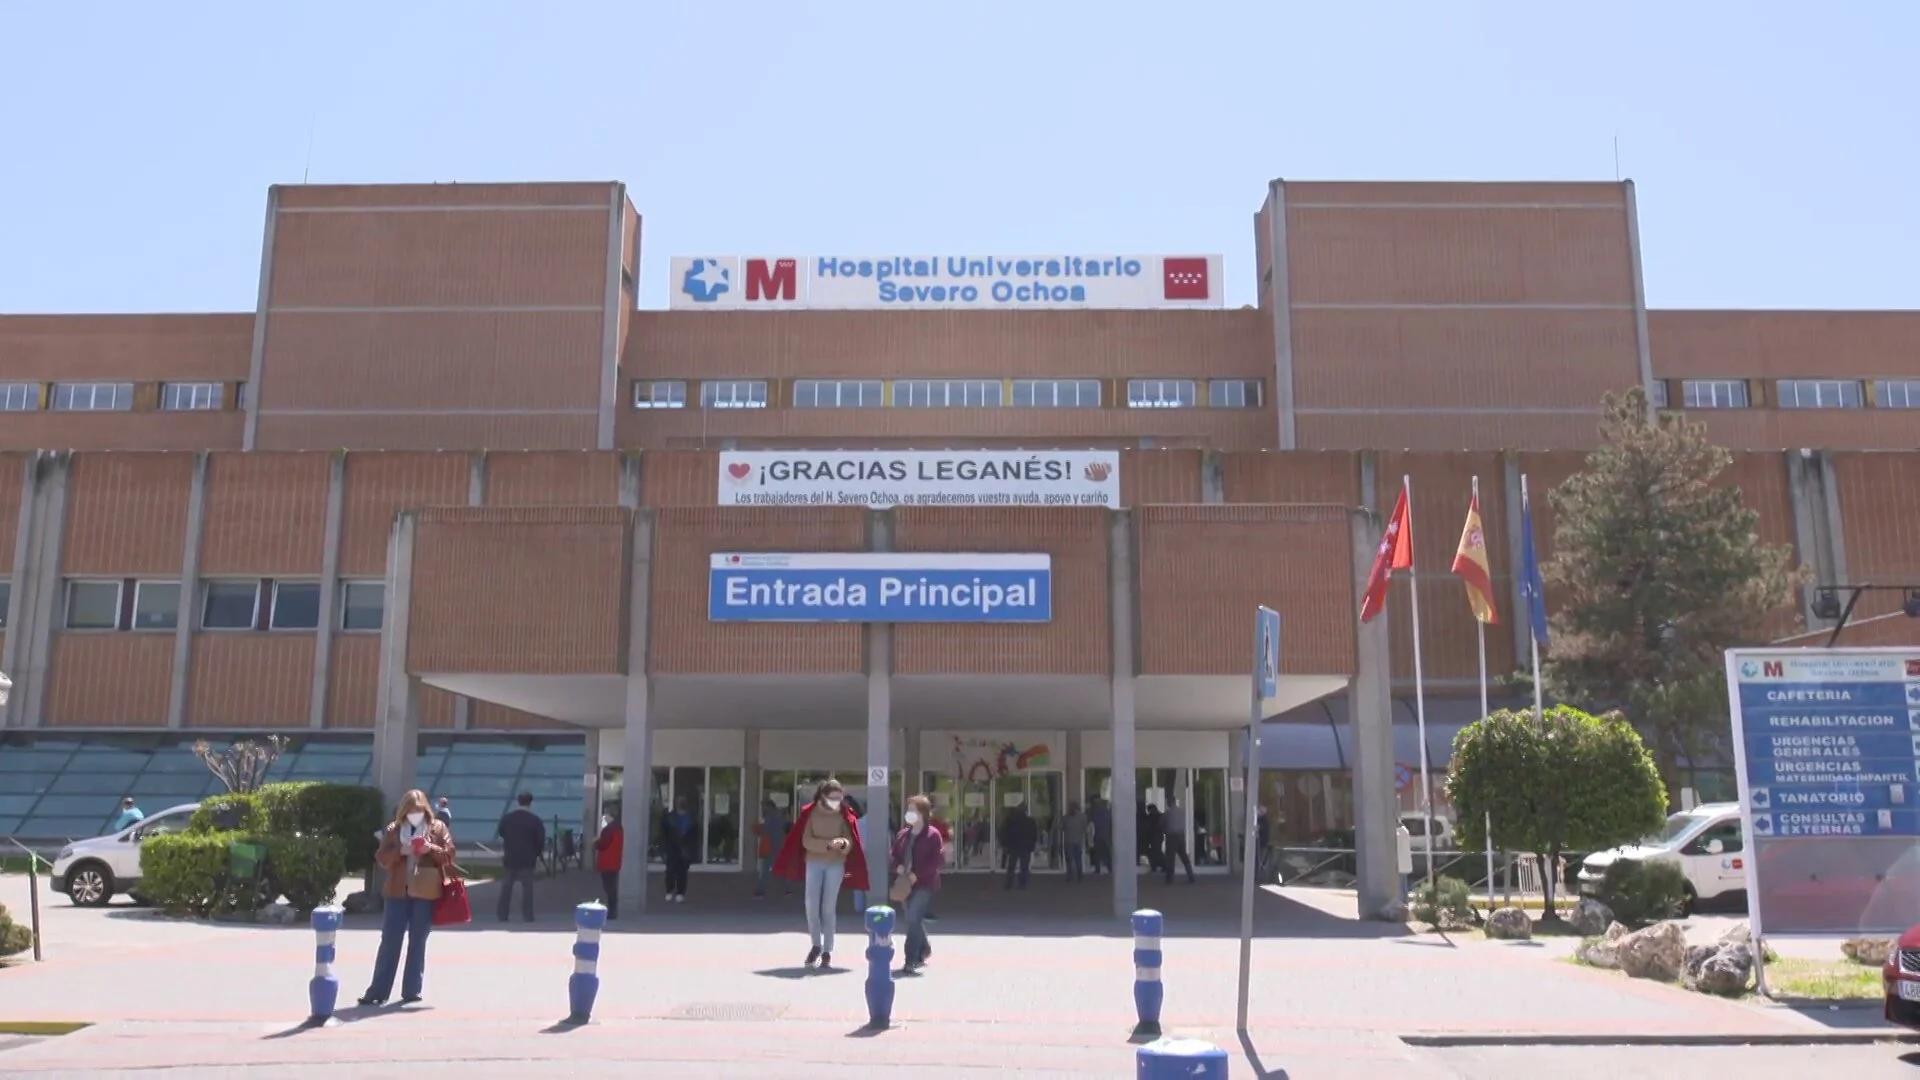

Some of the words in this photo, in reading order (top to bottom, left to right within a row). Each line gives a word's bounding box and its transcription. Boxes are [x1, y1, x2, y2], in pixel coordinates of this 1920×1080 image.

[818, 256, 938, 281] Hospital
[947, 256, 1141, 277] Universitario
[878, 281, 978, 302] Severo
[991, 280, 1086, 302] Ochoa
[760, 460, 907, 485] ¡GRACIAS
[918, 456, 1072, 481] LEGANÉS!
[735, 492, 752, 504] Los
[753, 491, 808, 505] trabajadores
[810, 491, 824, 504] del
[838, 490, 869, 504] Severo
[917, 491, 976, 505] agradecemos
[978, 492, 1011, 504] vuestra
[1043, 493, 1071, 505] apoyo
[726, 577, 867, 606] Entrada
[880, 577, 1036, 612] Principal
[1767, 690, 1851, 701] CAFETERIA
[1769, 715, 1894, 726] REHABILITACION
[1772, 735, 1856, 746] URGENCIAS
[1773, 747, 1861, 757] GENERALES
[1775, 761, 1861, 772] URGENCIAS
[1779, 792, 1865, 803] TANATORIO
[1780, 813, 1865, 823] CONSULTAS
[1781, 824, 1861, 835] EXTERNAS
